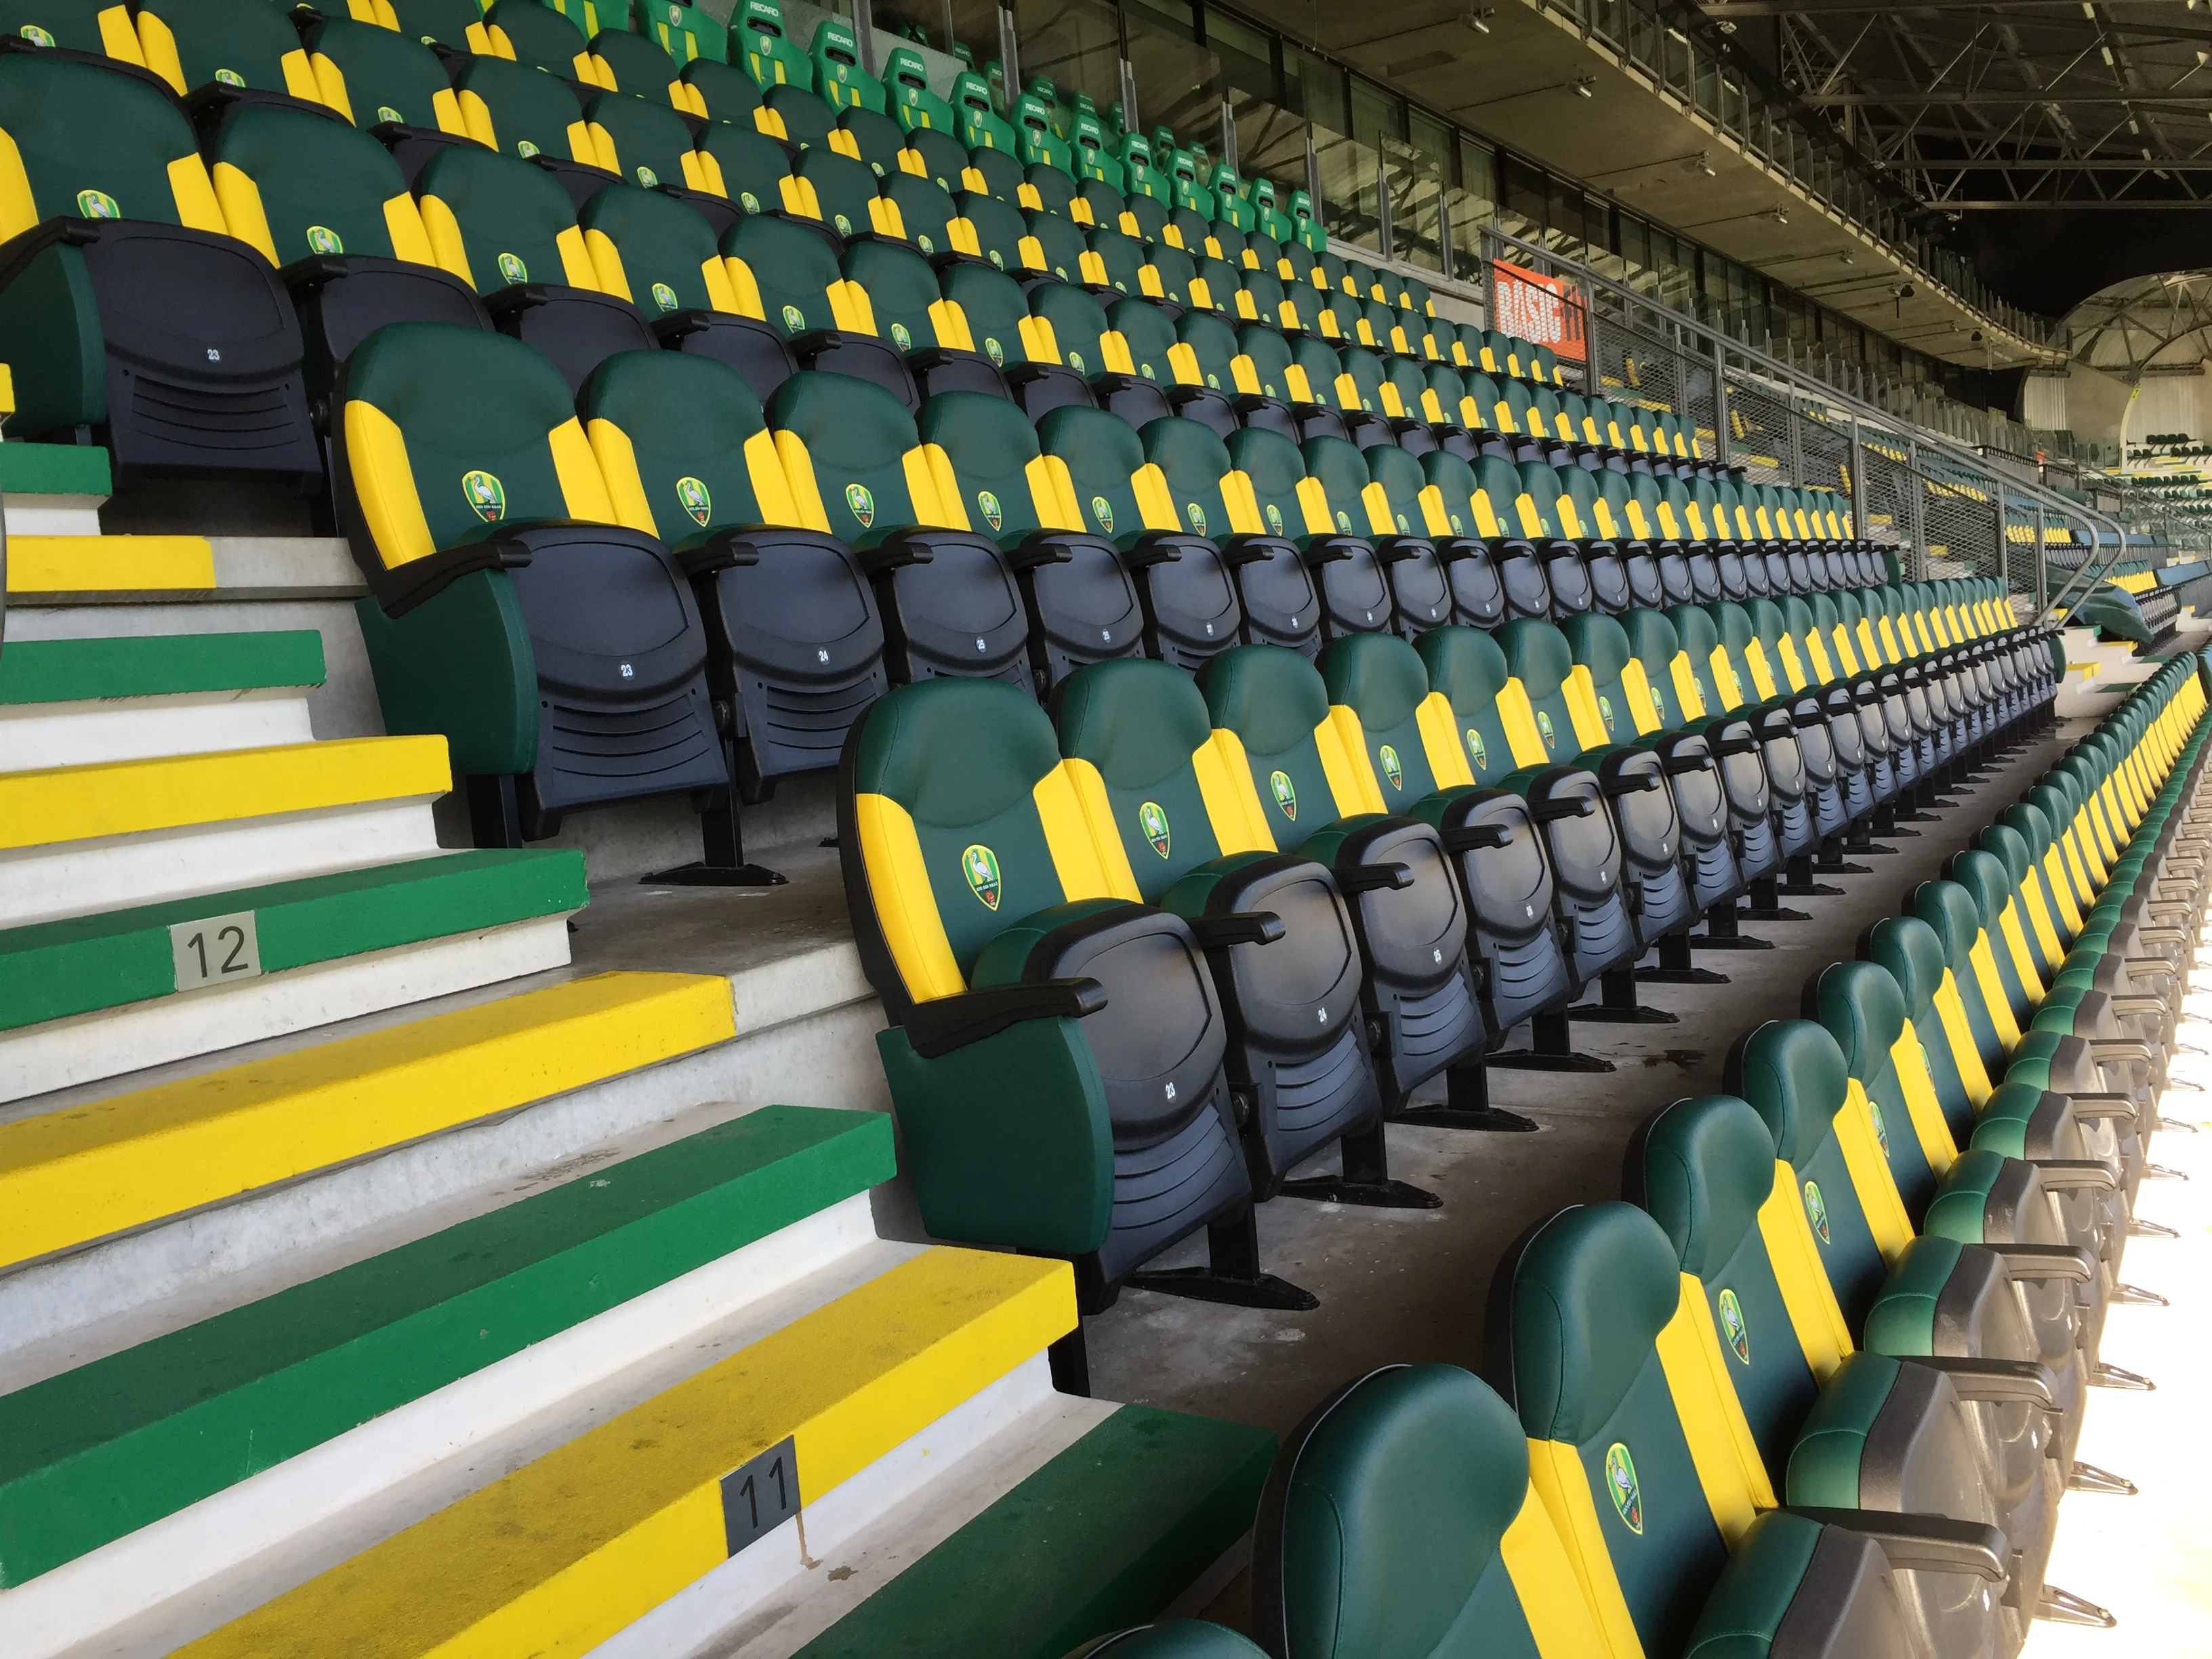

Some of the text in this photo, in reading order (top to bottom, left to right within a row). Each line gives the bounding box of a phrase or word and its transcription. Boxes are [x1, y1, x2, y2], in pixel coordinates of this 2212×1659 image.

[750, 1, 779, 17] RECARO
[827, 32, 853, 47] RECARO
[900, 58, 923, 71] RECARO
[966, 81, 987, 95] RECARO
[1025, 103, 1045, 115] RECARO
[1081, 123, 1099, 135] RECARO
[207, 348, 220, 361] 23
[819, 650, 829, 662] 24
[621, 663, 633, 676] 23
[187, 926, 249, 978] 12
[1318, 1007, 1327, 1022] 24
[1165, 1082, 1175, 1099] 23
[739, 1456, 787, 1529] 11
